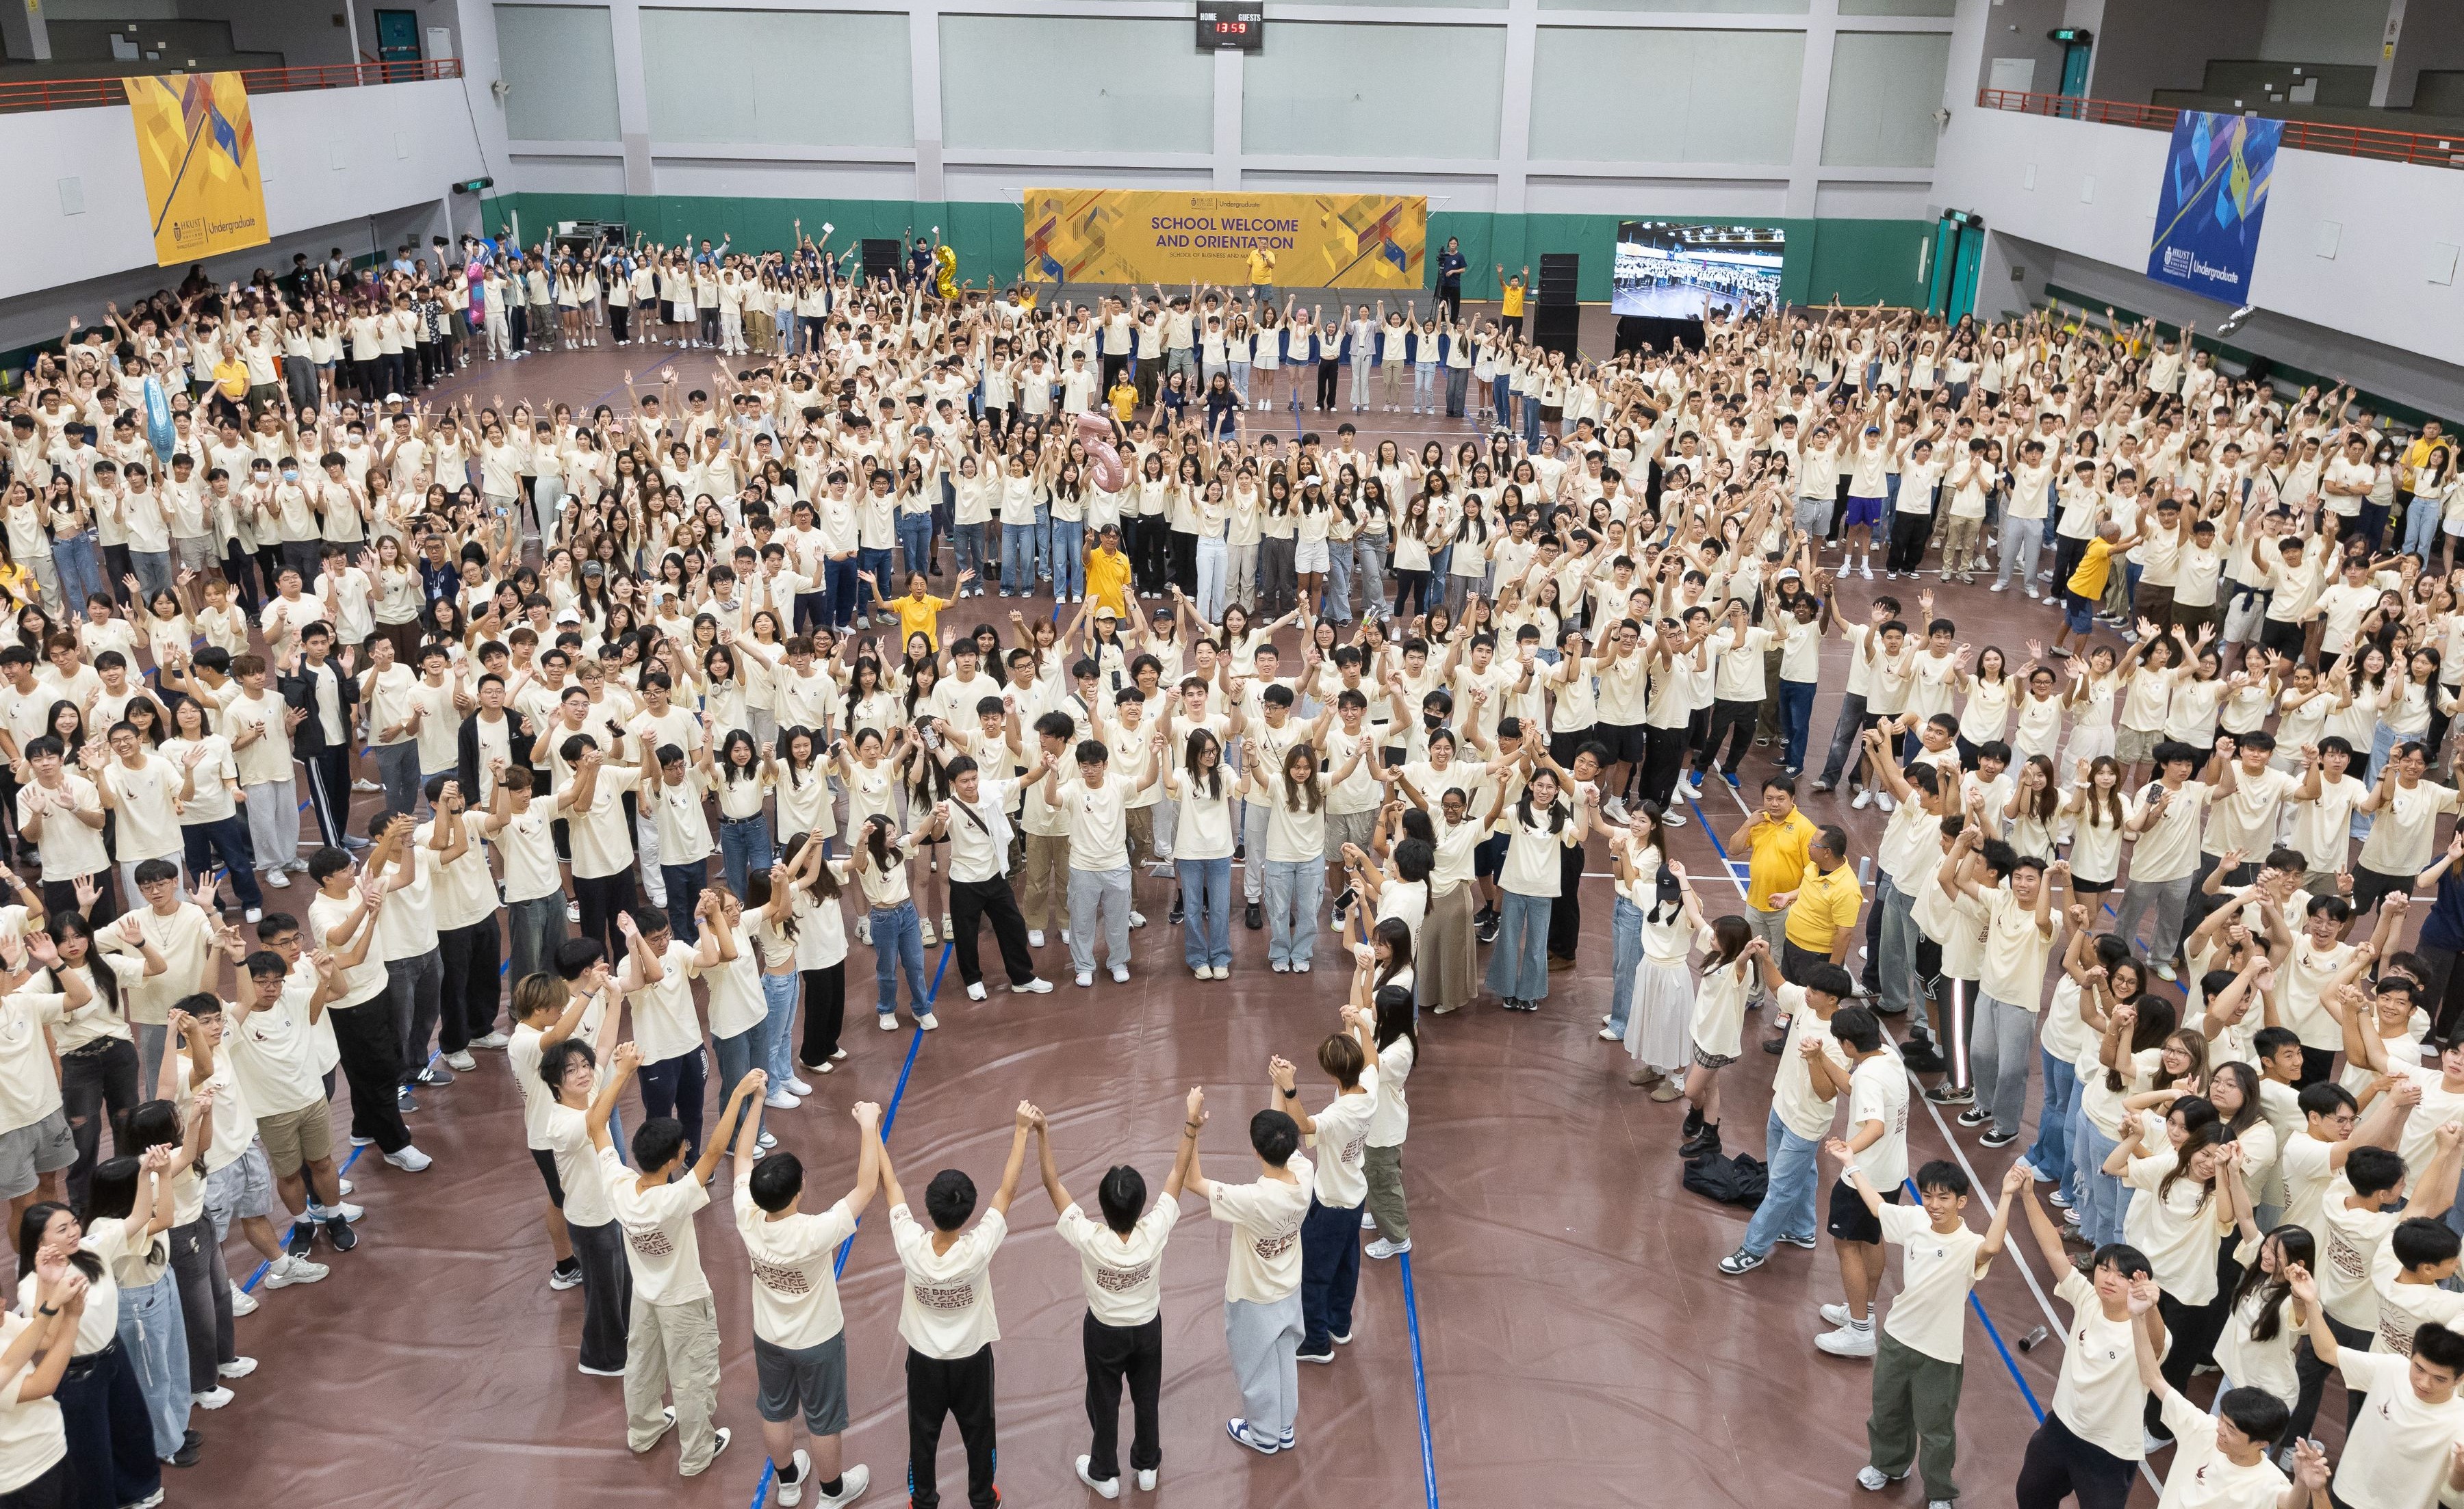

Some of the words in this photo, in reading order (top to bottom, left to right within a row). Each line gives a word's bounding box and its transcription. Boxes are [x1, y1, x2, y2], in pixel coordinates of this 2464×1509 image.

[1200, 12, 1217, 21] HOME
[1238, 13, 1261, 22] GUESTS
[180, 218, 201, 230] HKUST
[207, 214, 255, 234] Undergraduate
[1151, 216, 1217, 231] SCHOOL
[1221, 218, 1299, 232] WELCOME
[1155, 234, 1190, 247] AND
[1194, 235, 1294, 249] ORIENTAON
[2172, 248, 2191, 260] HKUST
[2193, 259, 2239, 284] Undergraduate
[1259, 1238, 1278, 1246] WE
[1098, 1268, 1116, 1276] WE
[770, 1275, 808, 1287] CARE
[1096, 1280, 1112, 1291] WE
[1097, 1275, 1118, 1285] WE
[768, 1281, 810, 1294] CREATE
[914, 1285, 929, 1294] WE
[932, 1284, 972, 1295] BRIDGE
[915, 1290, 934, 1302] WE
[937, 1291, 973, 1302] CARE
[933, 1297, 973, 1308] CREATE
